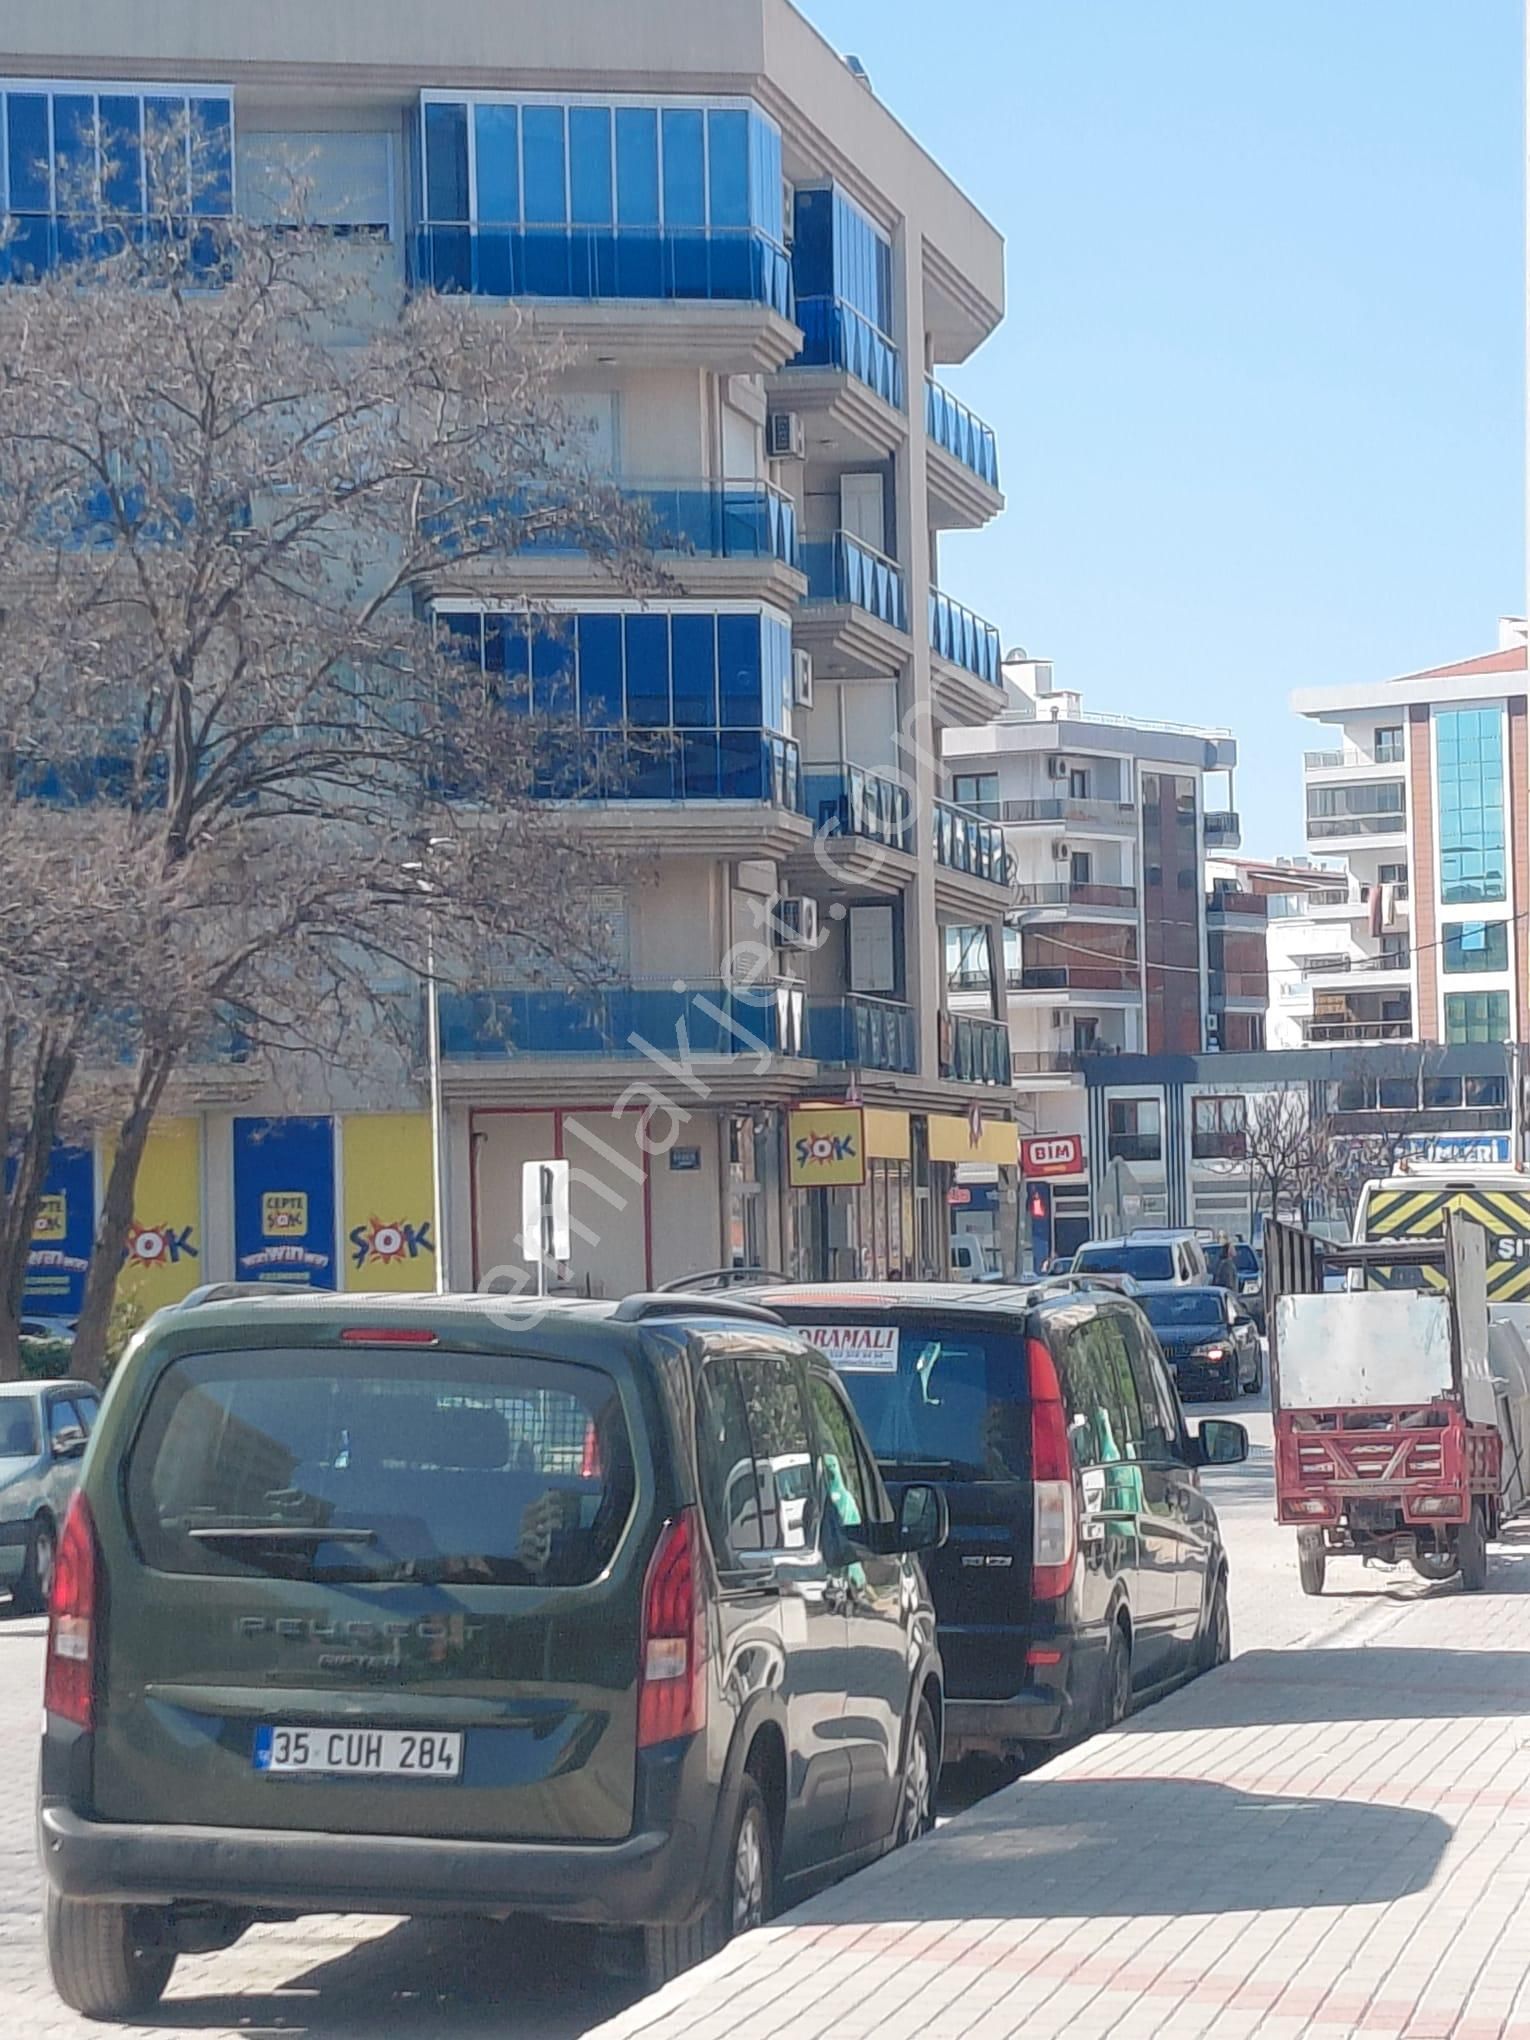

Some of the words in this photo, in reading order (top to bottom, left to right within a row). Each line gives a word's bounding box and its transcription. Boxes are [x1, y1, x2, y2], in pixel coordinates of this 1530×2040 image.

[796, 1133, 856, 1168] ŞOK
[122, 1225, 199, 1263] OK
[349, 1221, 435, 1269] ŞOK
[275, 1732, 309, 1764] 35
[327, 1734, 383, 1768] CUH
[399, 1736, 454, 1770] 284
